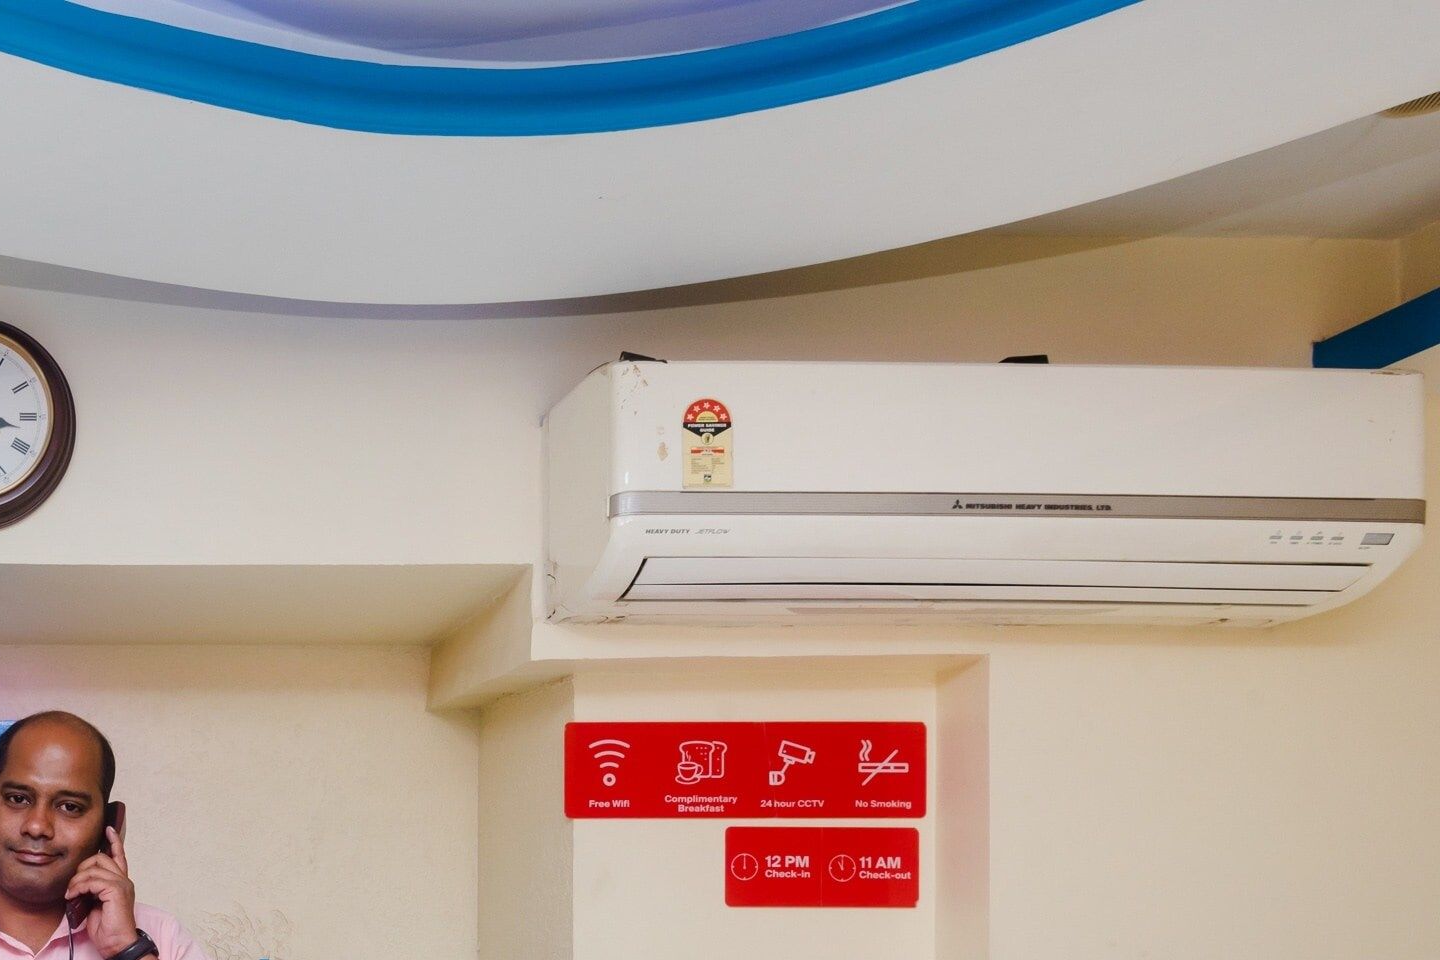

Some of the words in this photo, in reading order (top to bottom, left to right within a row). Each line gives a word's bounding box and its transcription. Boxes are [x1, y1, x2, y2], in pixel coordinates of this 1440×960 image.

[588, 799, 610, 808] Free
[611, 799, 630, 808] Wifi
[664, 794, 738, 806] Complimentary
[760, 799, 773, 808] 24
[773, 799, 795, 808] hour
[797, 799, 825, 808] CCTV
[855, 799, 869, 808] No
[870, 799, 912, 810] Smoking
[677, 803, 725, 813] Breakfast
[764, 855, 781, 868] 12
[784, 855, 810, 868] PM
[859, 856, 872, 869] 11
[875, 856, 902, 869] AM
[764, 869, 811, 879] Check-in
[858, 870, 912, 880] Check-out
